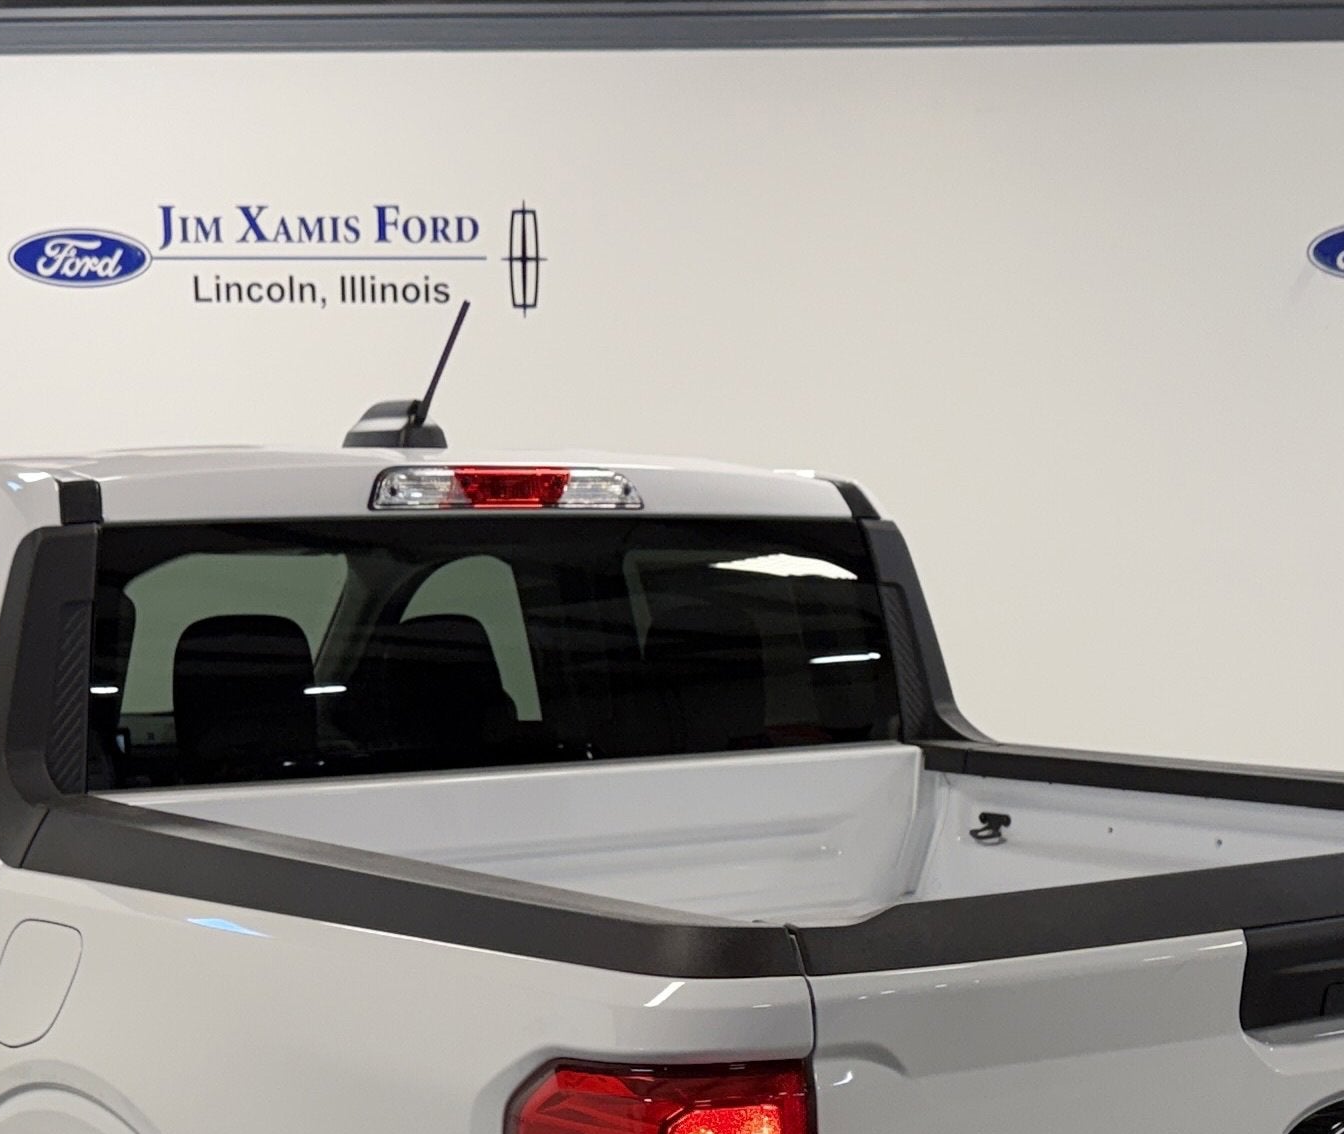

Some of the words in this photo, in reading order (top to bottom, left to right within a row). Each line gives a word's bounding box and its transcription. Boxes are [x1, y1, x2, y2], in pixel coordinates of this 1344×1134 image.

[373, 205, 480, 245] FORD
[36, 237, 123, 279] Ford
[193, 275, 328, 308] Lincoln,
[340, 275, 451, 304] Illinois
